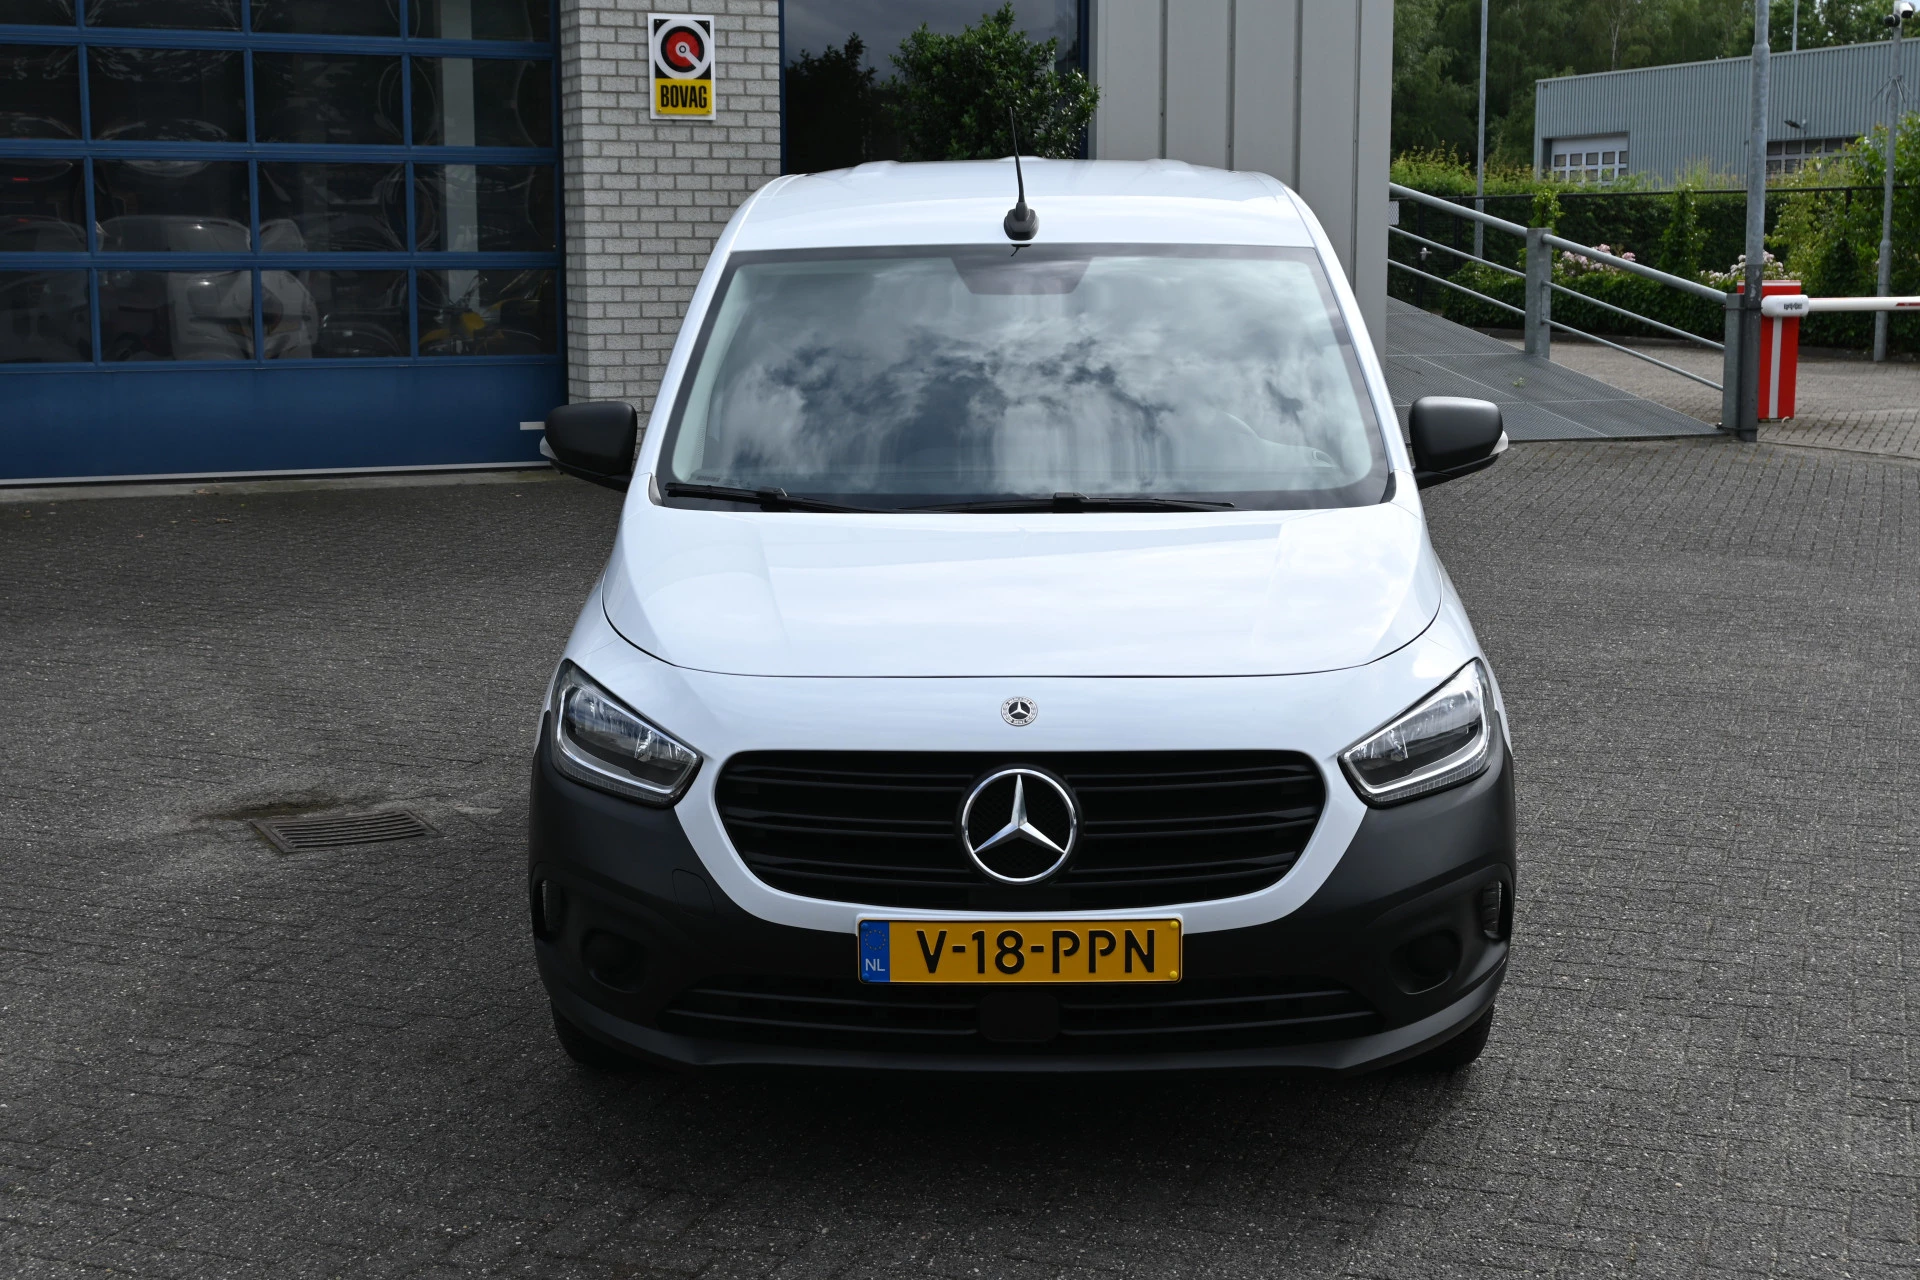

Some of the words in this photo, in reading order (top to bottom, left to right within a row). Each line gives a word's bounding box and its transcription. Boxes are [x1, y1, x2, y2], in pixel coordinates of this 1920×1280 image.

[660, 85, 707, 108] BOVAG
[916, 929, 1155, 974] V-18-PPN
[865, 958, 886, 972] NL
